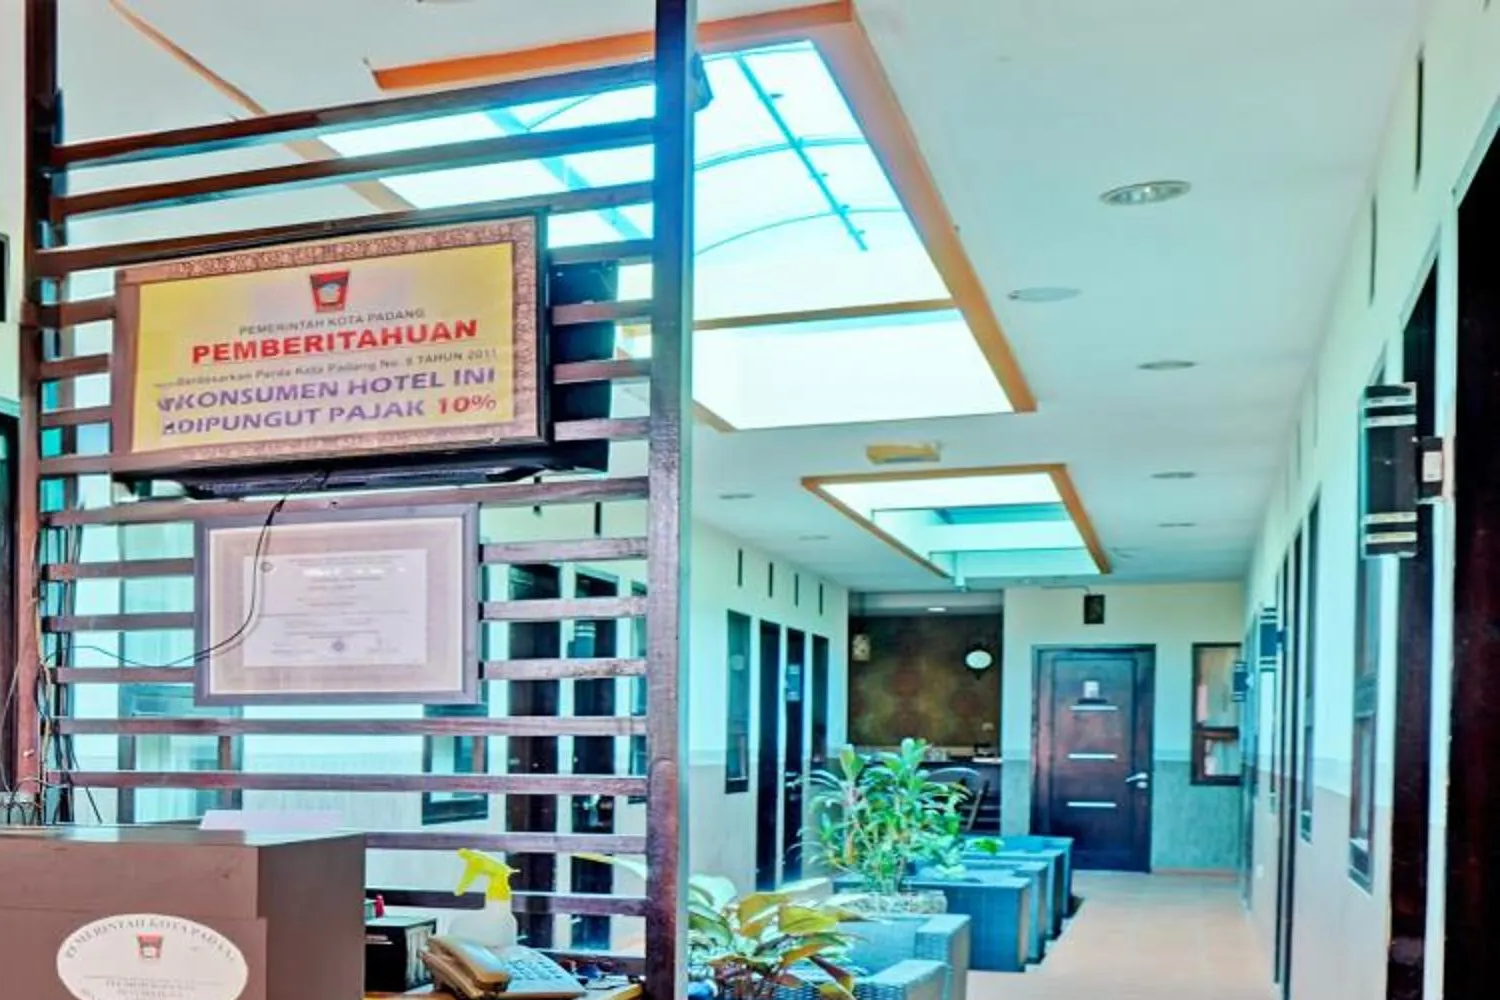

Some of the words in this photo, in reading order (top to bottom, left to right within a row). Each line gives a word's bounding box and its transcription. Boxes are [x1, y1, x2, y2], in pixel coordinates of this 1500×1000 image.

[239, 318, 327, 336] PEMERINTAH
[328, 315, 364, 327] KOTA
[367, 308, 425, 322] PADANG
[192, 319, 477, 364] PEMBERITAHUAN
[327, 361, 376, 373] Padang
[418, 353, 463, 365] TAHUN
[467, 349, 497, 360] 2011
[348, 371, 445, 395] HOTEL
[453, 367, 495, 386] INI
[329, 400, 425, 422] PAJAK
[438, 394, 497, 415] 10%
